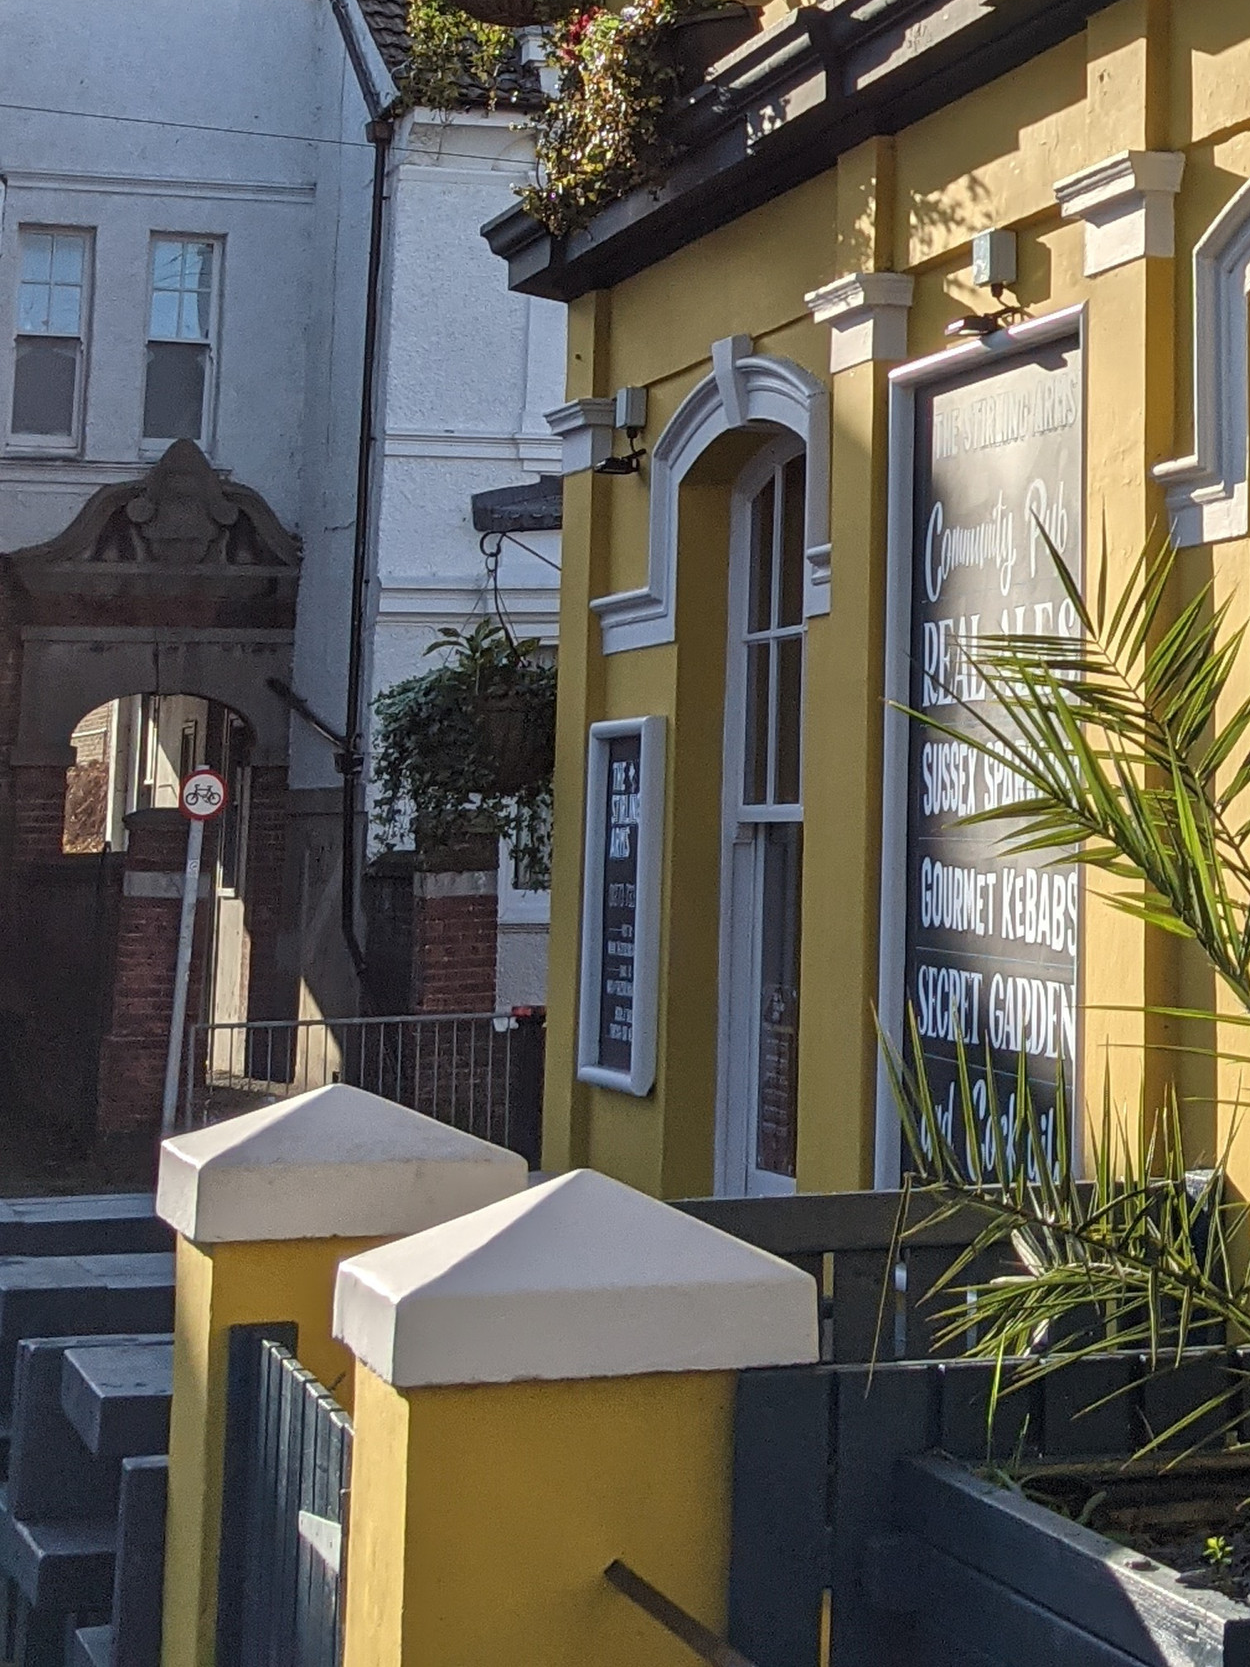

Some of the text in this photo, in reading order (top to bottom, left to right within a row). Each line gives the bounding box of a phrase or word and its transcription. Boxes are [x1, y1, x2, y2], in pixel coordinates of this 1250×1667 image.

[935, 408, 960, 459] THE
[925, 478, 1068, 603] Community Pub
[922, 613, 986, 708] REAL
[922, 741, 978, 817] SUSSEX
[921, 856, 1078, 956] GOURMET KEBABS
[918, 965, 1075, 1065] SECRET GARDEN
